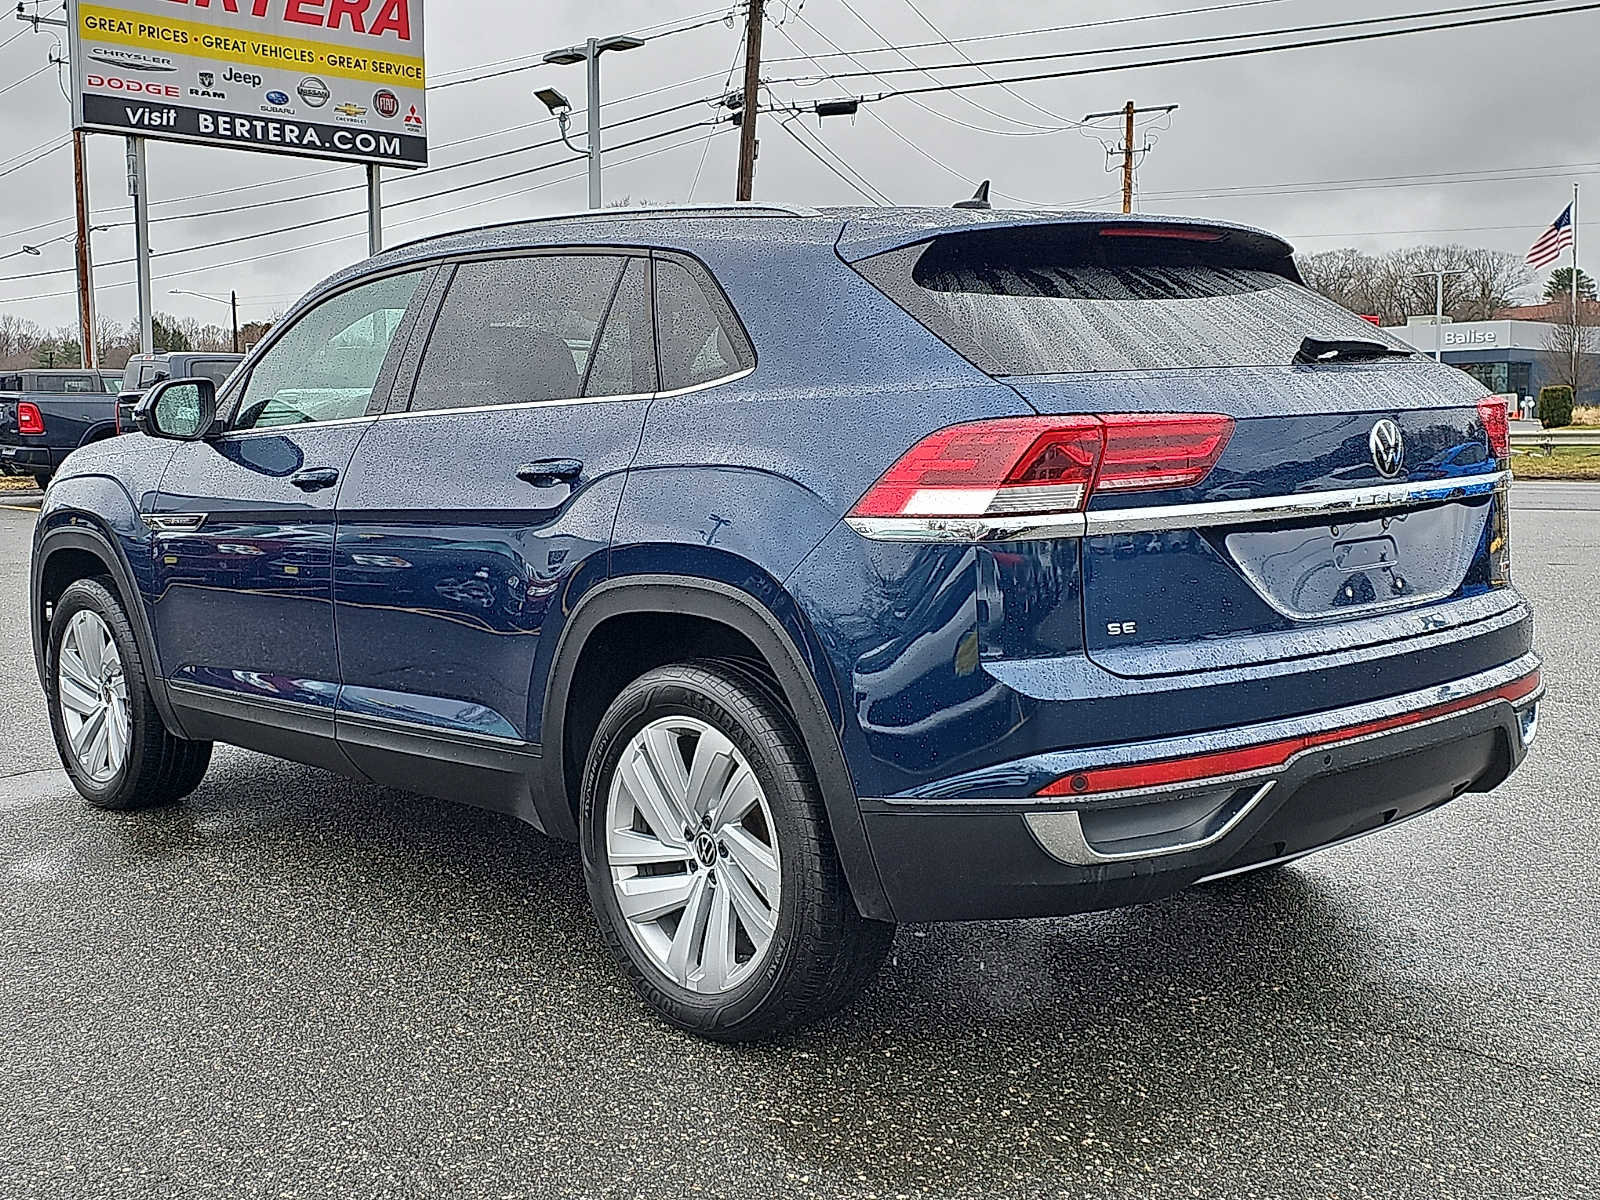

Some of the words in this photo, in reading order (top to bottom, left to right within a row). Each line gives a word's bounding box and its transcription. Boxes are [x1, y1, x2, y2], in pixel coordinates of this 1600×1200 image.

[84, 16, 134, 35] GREAT
[138, 24, 189, 44] PRICES
[202, 35, 247, 53] GREAT
[251, 42, 315, 63] VEHICLES
[327, 54, 368, 71] GREAT
[371, 61, 422, 79] SERVICE
[92, 48, 171, 65] CHRYSLER
[222, 67, 262, 88] Jeep
[87, 75, 180, 97] DODGE
[189, 88, 226, 100] RAM
[301, 87, 328, 98] NISSAN
[260, 105, 295, 115] SUBARU
[379, 97, 394, 111] FIAT
[125, 107, 177, 126] Visit
[198, 113, 401, 155] BERTERA.COM
[1445, 329, 1496, 345] Balise
[1107, 622, 1136, 635] SE
